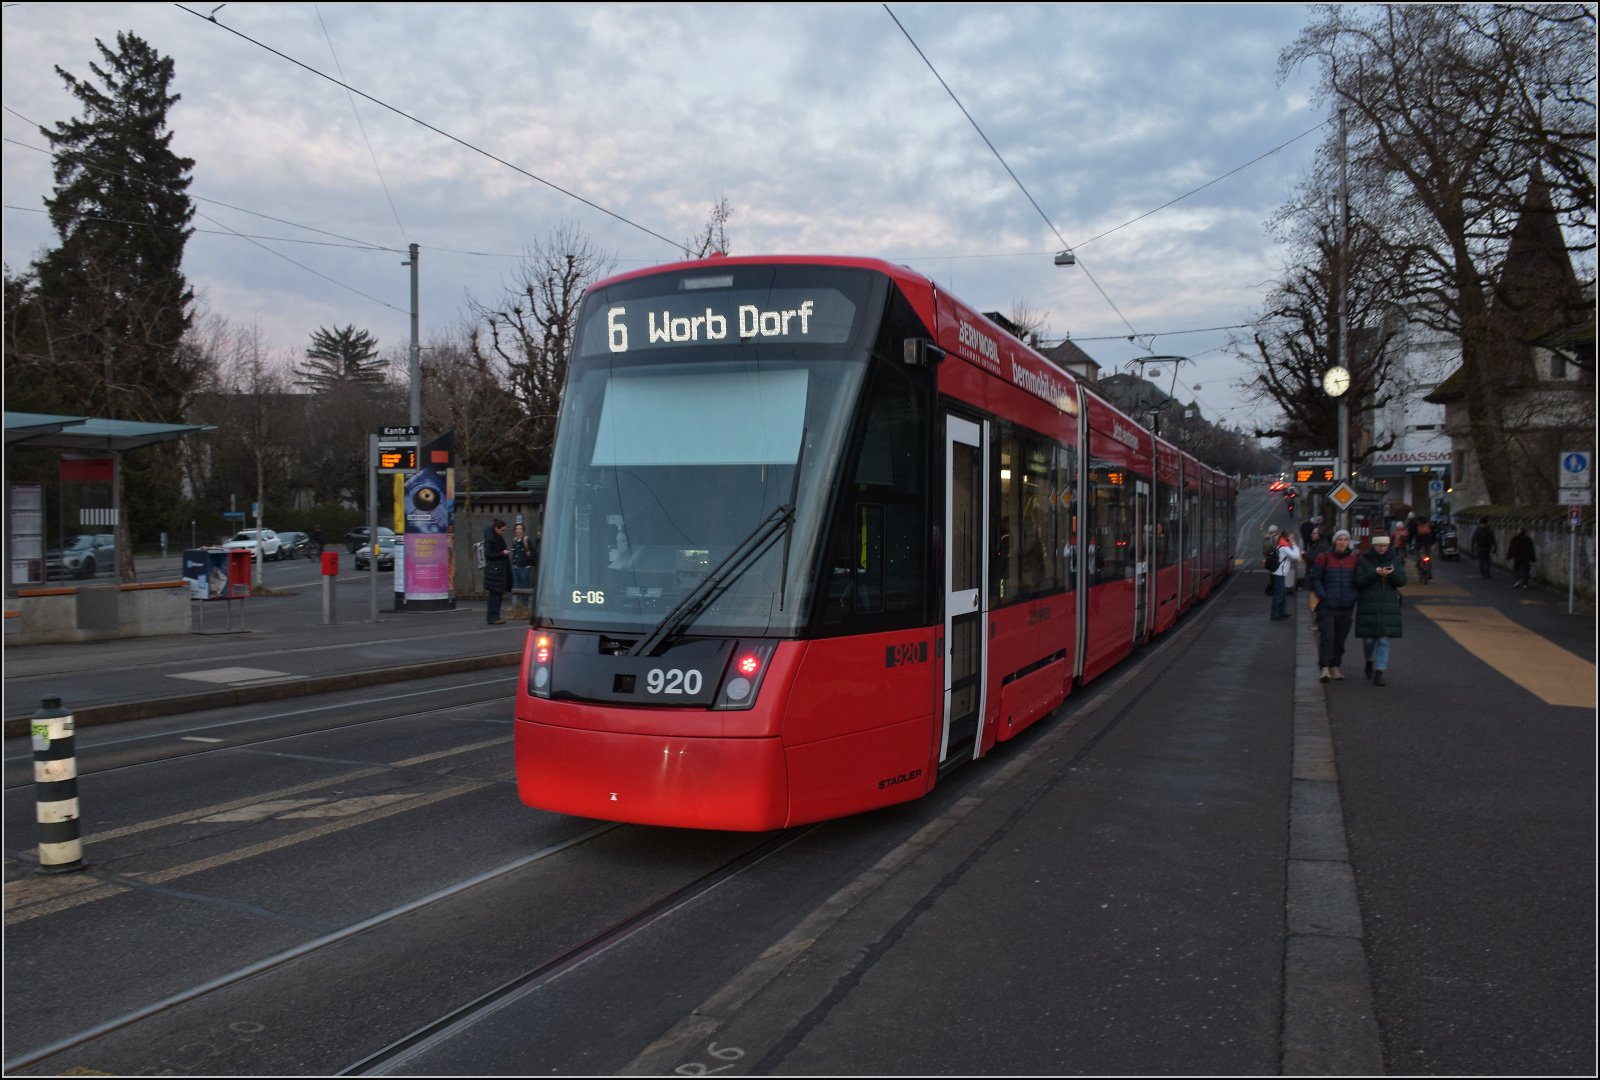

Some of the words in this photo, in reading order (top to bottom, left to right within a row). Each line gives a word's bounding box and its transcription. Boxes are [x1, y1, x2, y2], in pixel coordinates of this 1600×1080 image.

[608, 307, 628, 352] 6
[649, 308, 727, 343] Worb
[739, 300, 814, 338] Dorf
[384, 427, 407, 435] Kante
[1323, 449, 1330, 457] B
[572, 590, 605, 604] 6-06
[893, 641, 922, 668] 920
[647, 668, 703, 695] 920
[878, 768, 922, 790] STADLER
